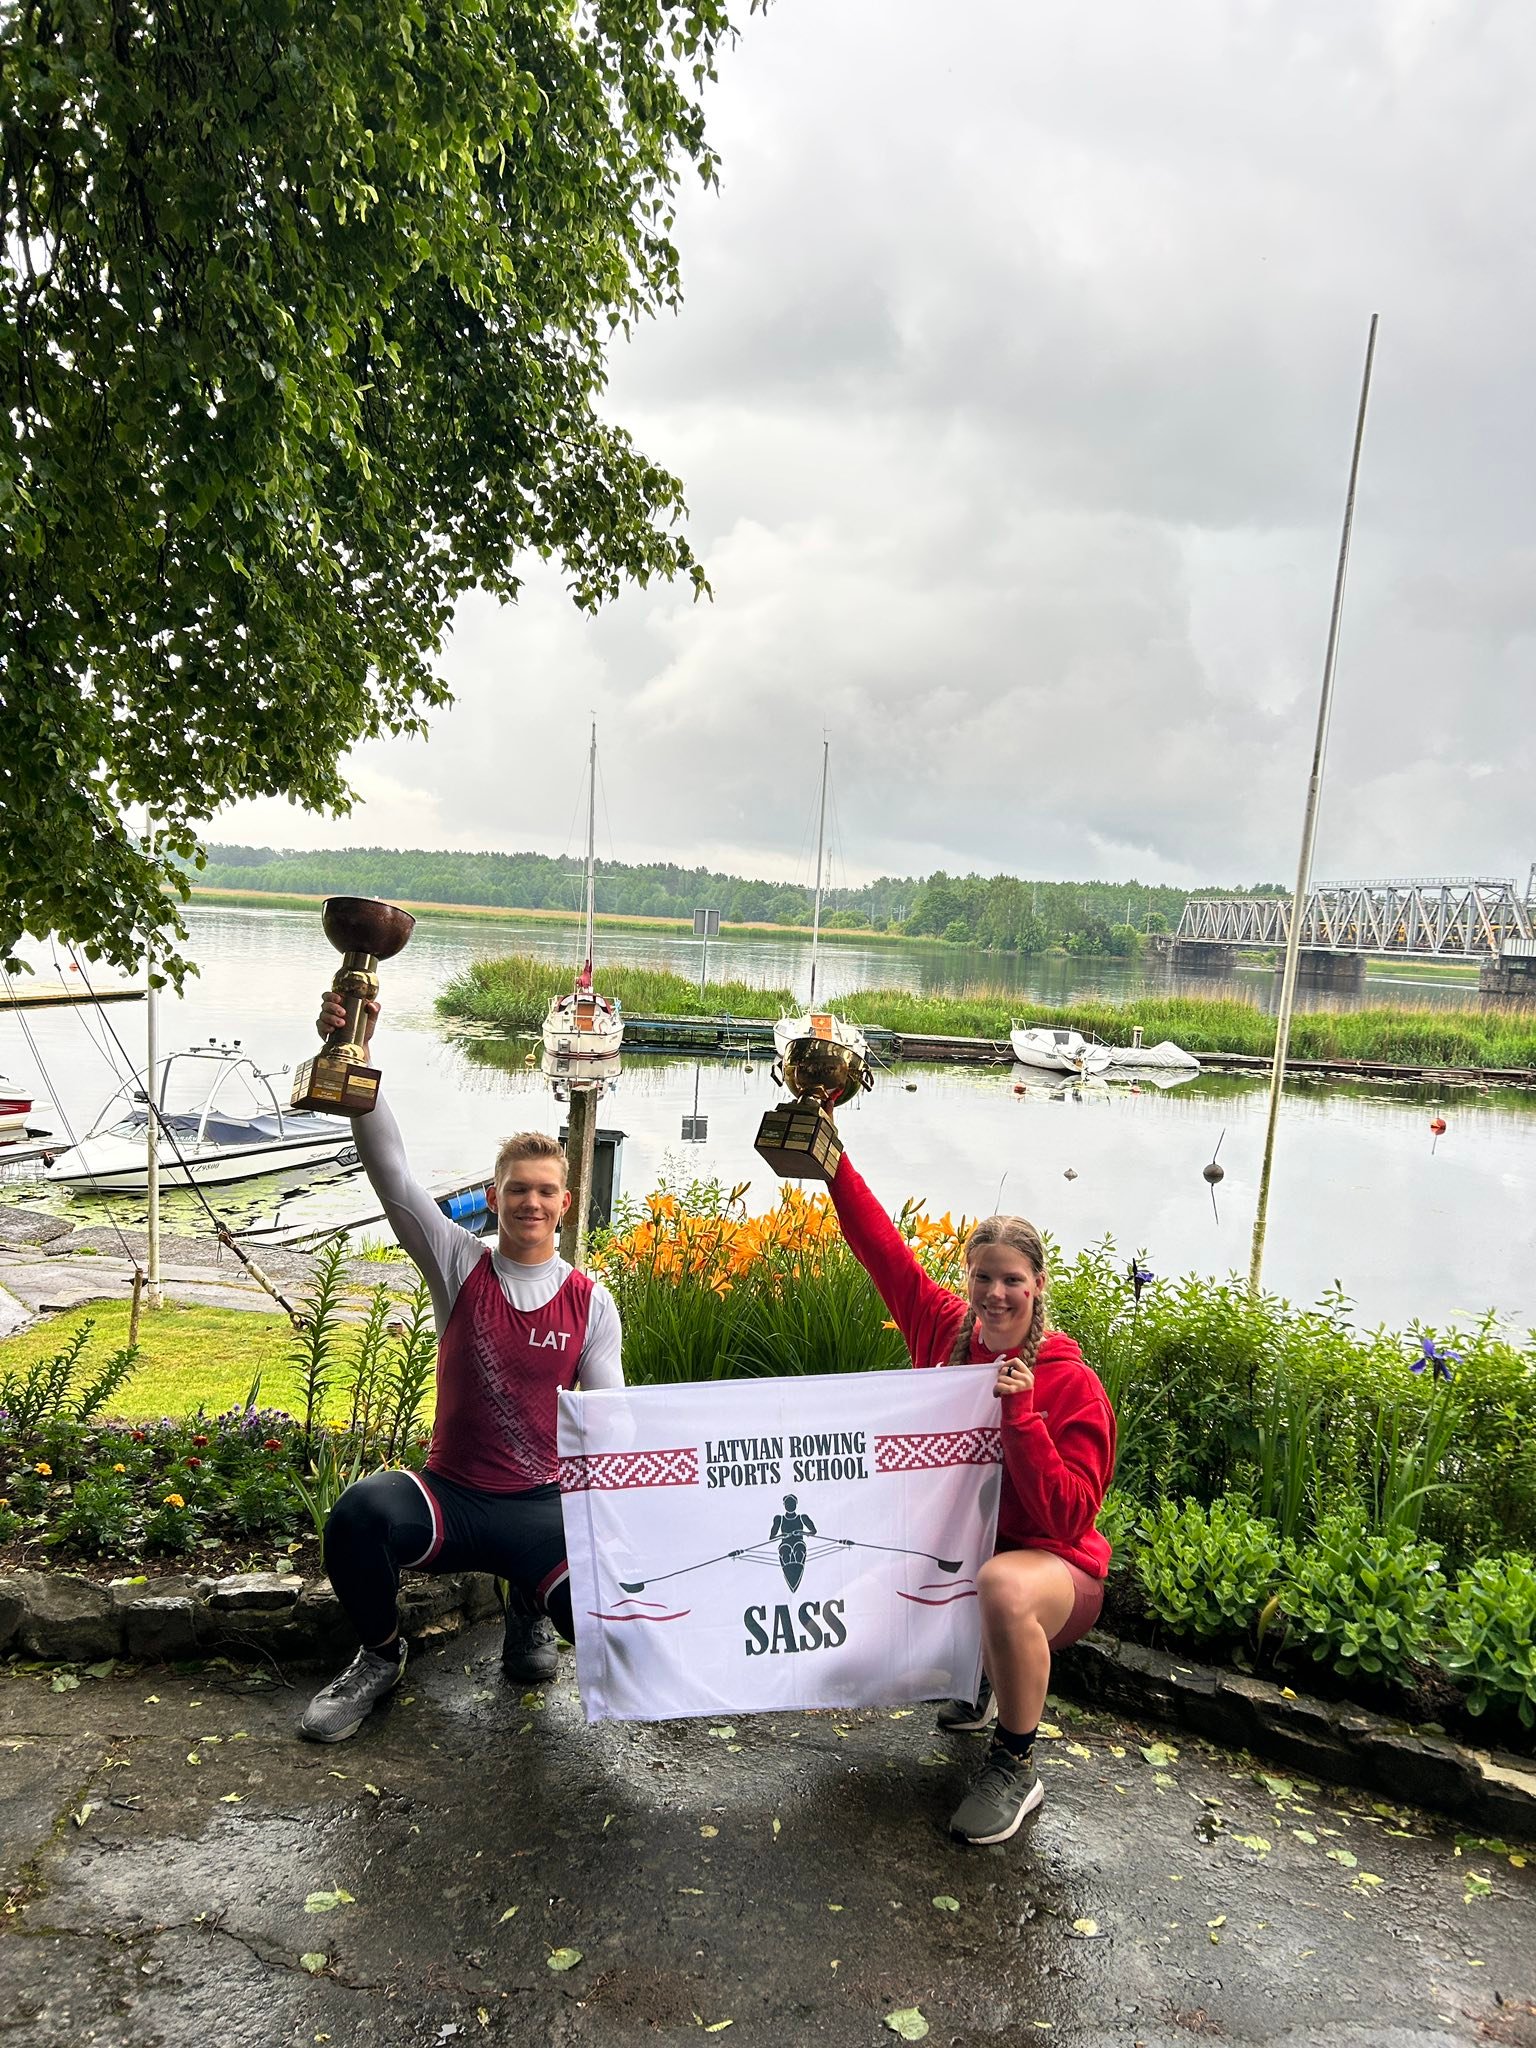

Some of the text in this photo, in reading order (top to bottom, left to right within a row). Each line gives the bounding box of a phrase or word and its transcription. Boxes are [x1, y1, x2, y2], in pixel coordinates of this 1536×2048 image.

[528, 1327, 571, 1351] LAT
[705, 1431, 866, 1463] LATVIAN ROWING
[706, 1457, 868, 1488] SPORTS SCHOOL
[743, 1599, 847, 1656] SASS
